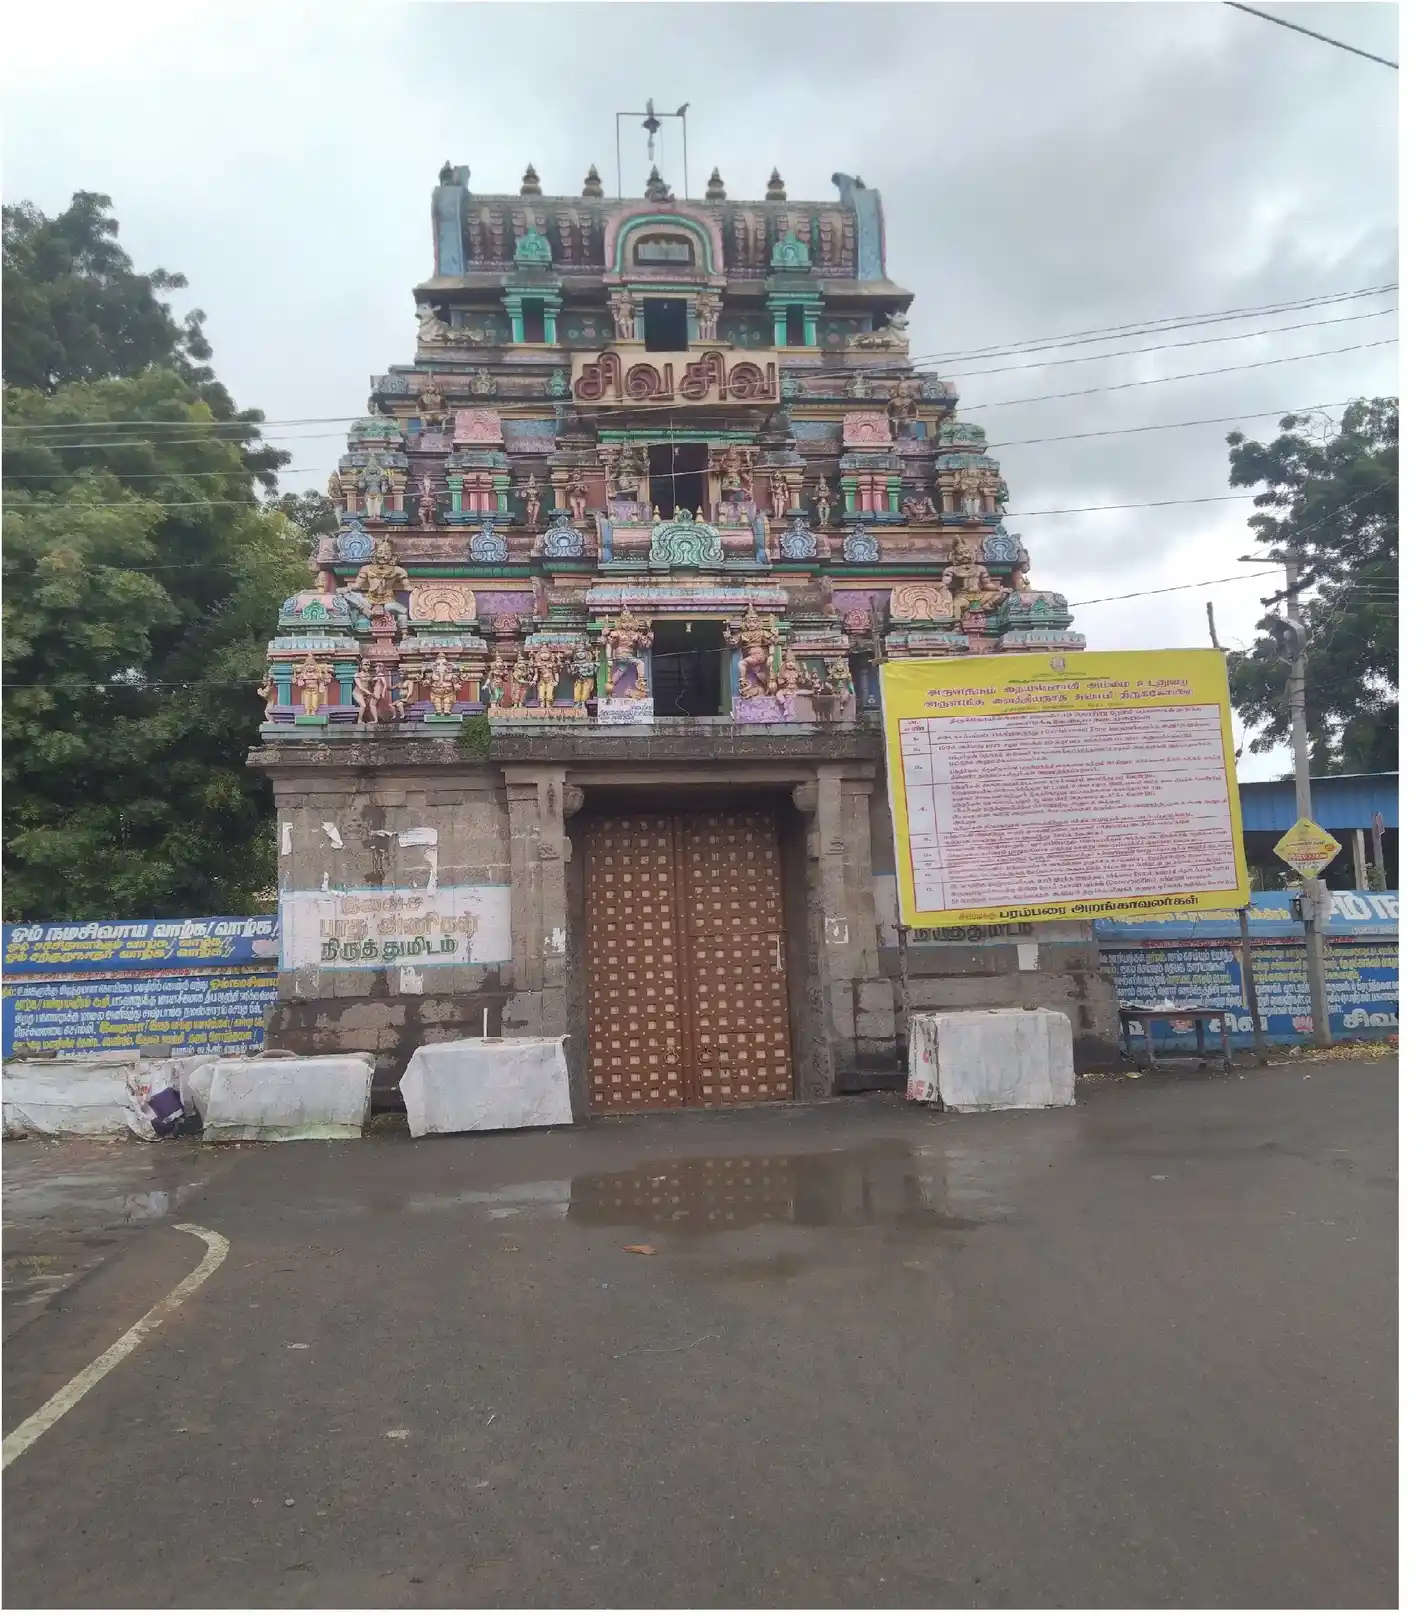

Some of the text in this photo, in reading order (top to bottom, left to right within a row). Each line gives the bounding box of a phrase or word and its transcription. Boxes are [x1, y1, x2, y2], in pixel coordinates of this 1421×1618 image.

[999, 905, 1066, 920] பரம்பரை
[1071, 894, 1199, 914] அறங்காவலர்கள்
[11, 924, 44, 943] ஓம்
[45, 922, 149, 941] நமசிவாய
